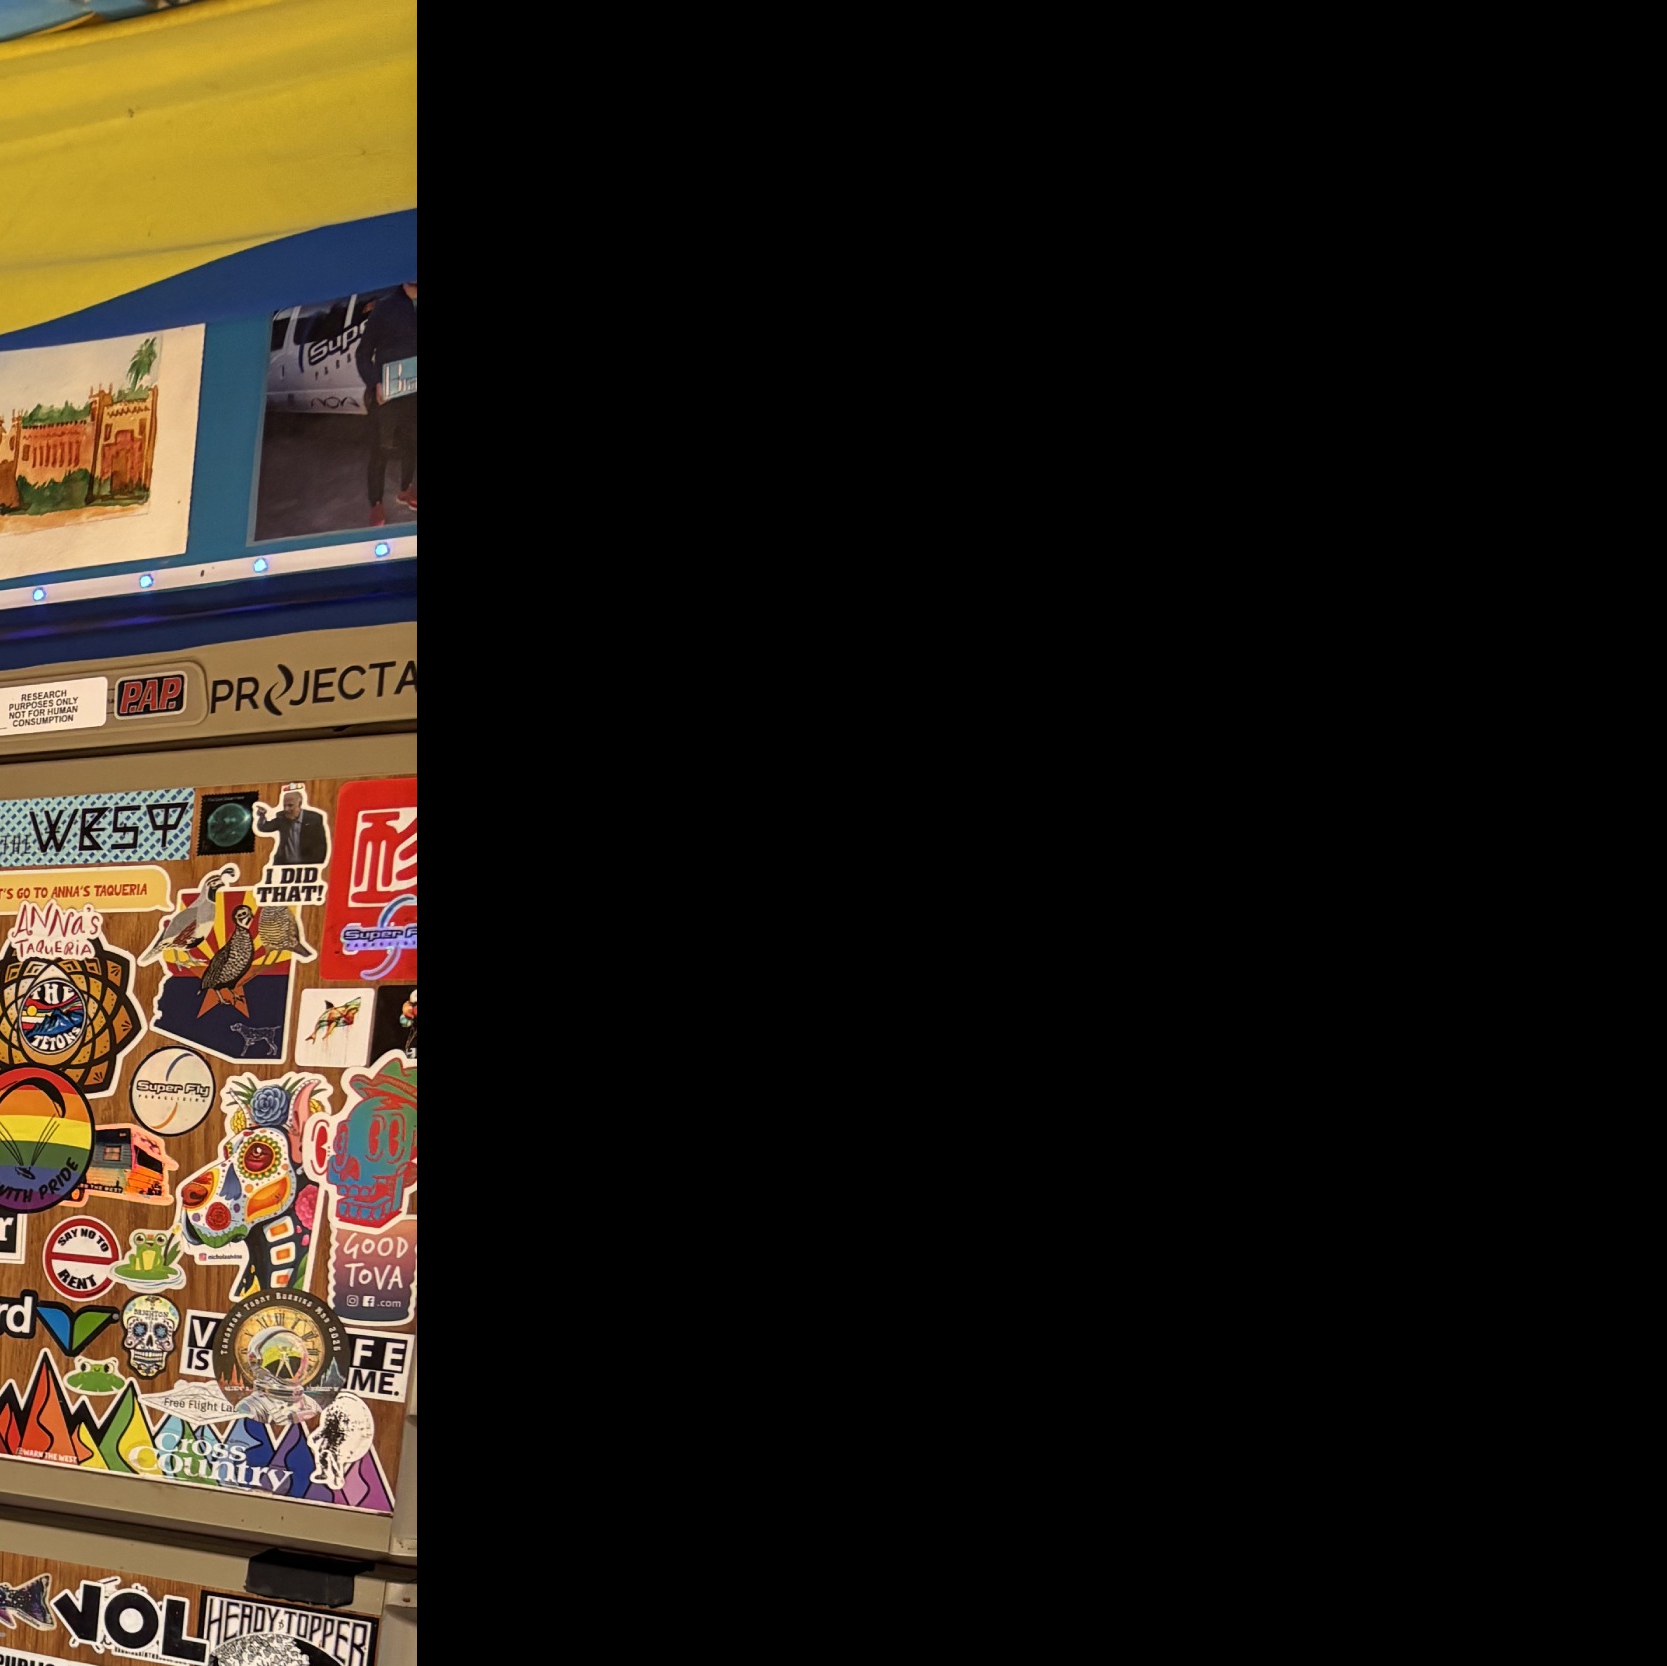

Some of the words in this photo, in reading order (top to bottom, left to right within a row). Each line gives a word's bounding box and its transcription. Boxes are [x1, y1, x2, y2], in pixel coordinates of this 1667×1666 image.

[21, 690, 67, 700] RESEARCH
[9, 698, 54, 711] PURPOSES
[56, 697, 78, 706] ONLY
[9, 711, 24, 719] NOT
[27, 709, 45, 718] FOR
[47, 705, 78, 716] HUMAN
[13, 715, 74, 727] CONSUMPTION
[265, 868, 272, 884] I
[280, 867, 318, 884] DID
[16, 887, 31, 898] GO
[33, 886, 48, 897] TO
[52, 884, 91, 897] ANNA'S
[94, 883, 148, 896] TAQUERIA
[257, 885, 324, 902] THAT!
[137, 1081, 181, 1095] Super
[184, 1082, 209, 1099] Fly
[56, 1229, 77, 1248] SAY
[80, 1228, 97, 1240] NO
[97, 1234, 110, 1253] TO
[343, 1233, 409, 1258] GOOD
[58, 1267, 97, 1291] RENT
[163, 1398, 186, 1408] Free
[189, 1398, 213, 1414] Flight
[156, 1432, 246, 1461] Cross
[128, 1445, 294, 1491] Country
